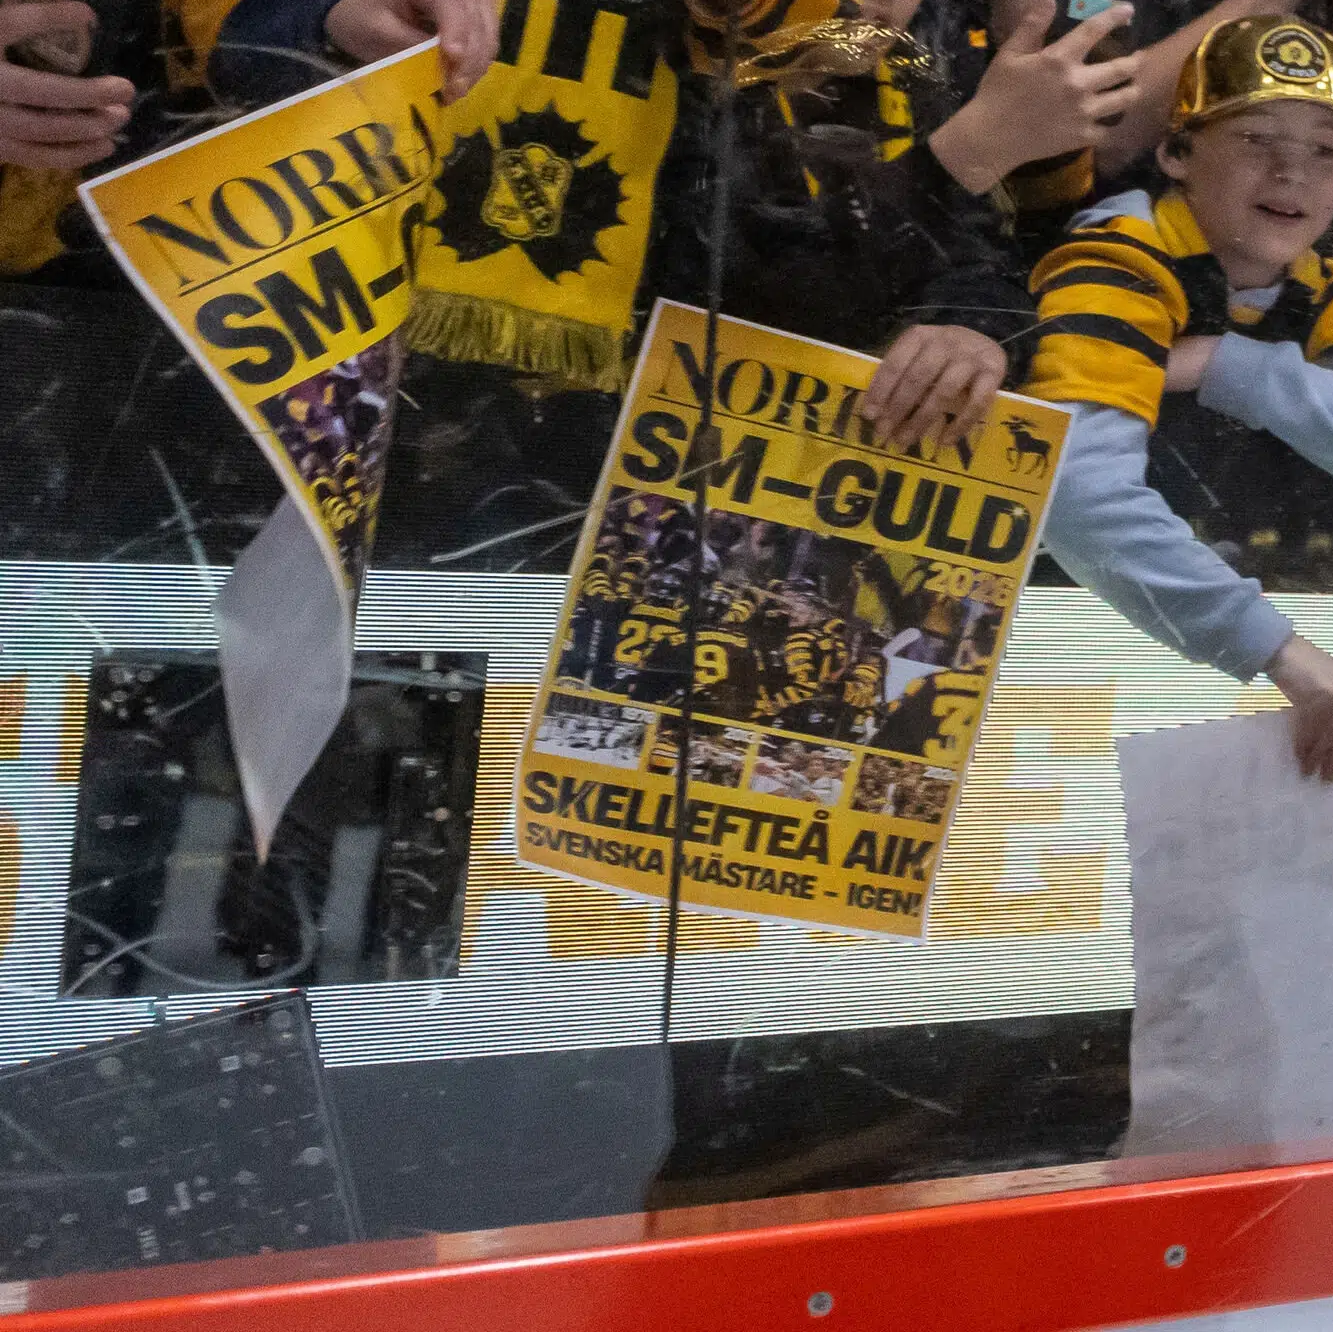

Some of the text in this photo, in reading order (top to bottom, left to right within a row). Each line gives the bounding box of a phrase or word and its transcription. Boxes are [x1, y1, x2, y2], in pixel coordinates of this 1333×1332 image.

[621, 409, 1031, 565] SM-GULD
[523, 770, 935, 882] SKELLEFTEÅ AIK
[524, 820, 666, 877] SVENSKA
[677, 850, 818, 901] MÄSTARE
[846, 881, 923, 919] IGEN!
